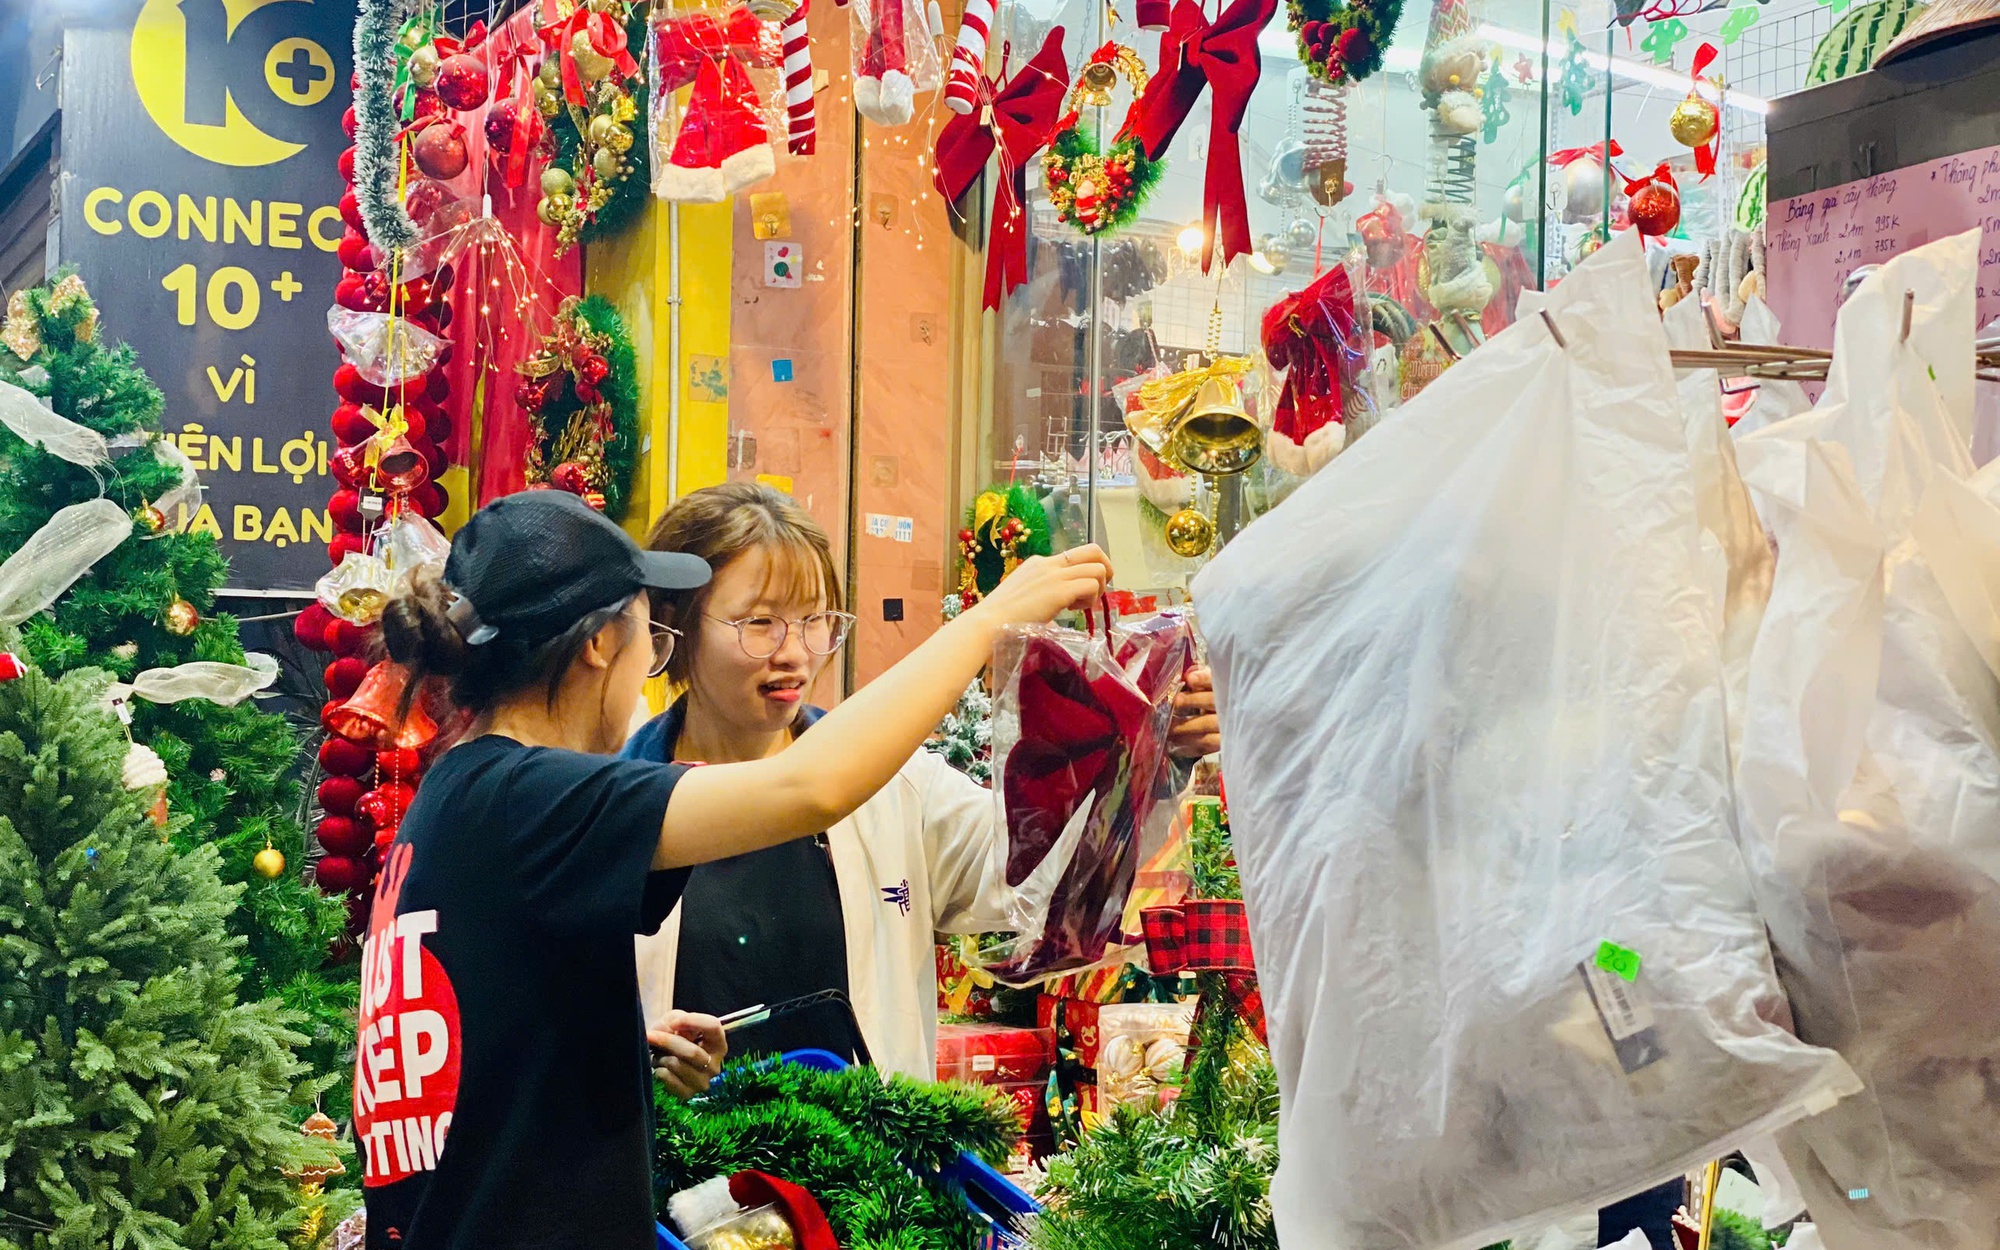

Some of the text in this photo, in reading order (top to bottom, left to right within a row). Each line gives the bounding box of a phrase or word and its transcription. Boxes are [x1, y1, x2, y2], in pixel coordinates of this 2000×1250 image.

[1940, 158, 1977, 193] Thông
[83, 186, 340, 253] CONNEC
[1785, 197, 1815, 232] Bảng
[1844, 186, 1861, 219] cây
[1776, 229, 1801, 261] Thông
[161, 263, 303, 330] 10+
[252, 430, 328, 484] LỢI
[233, 504, 332, 548] BẠN
